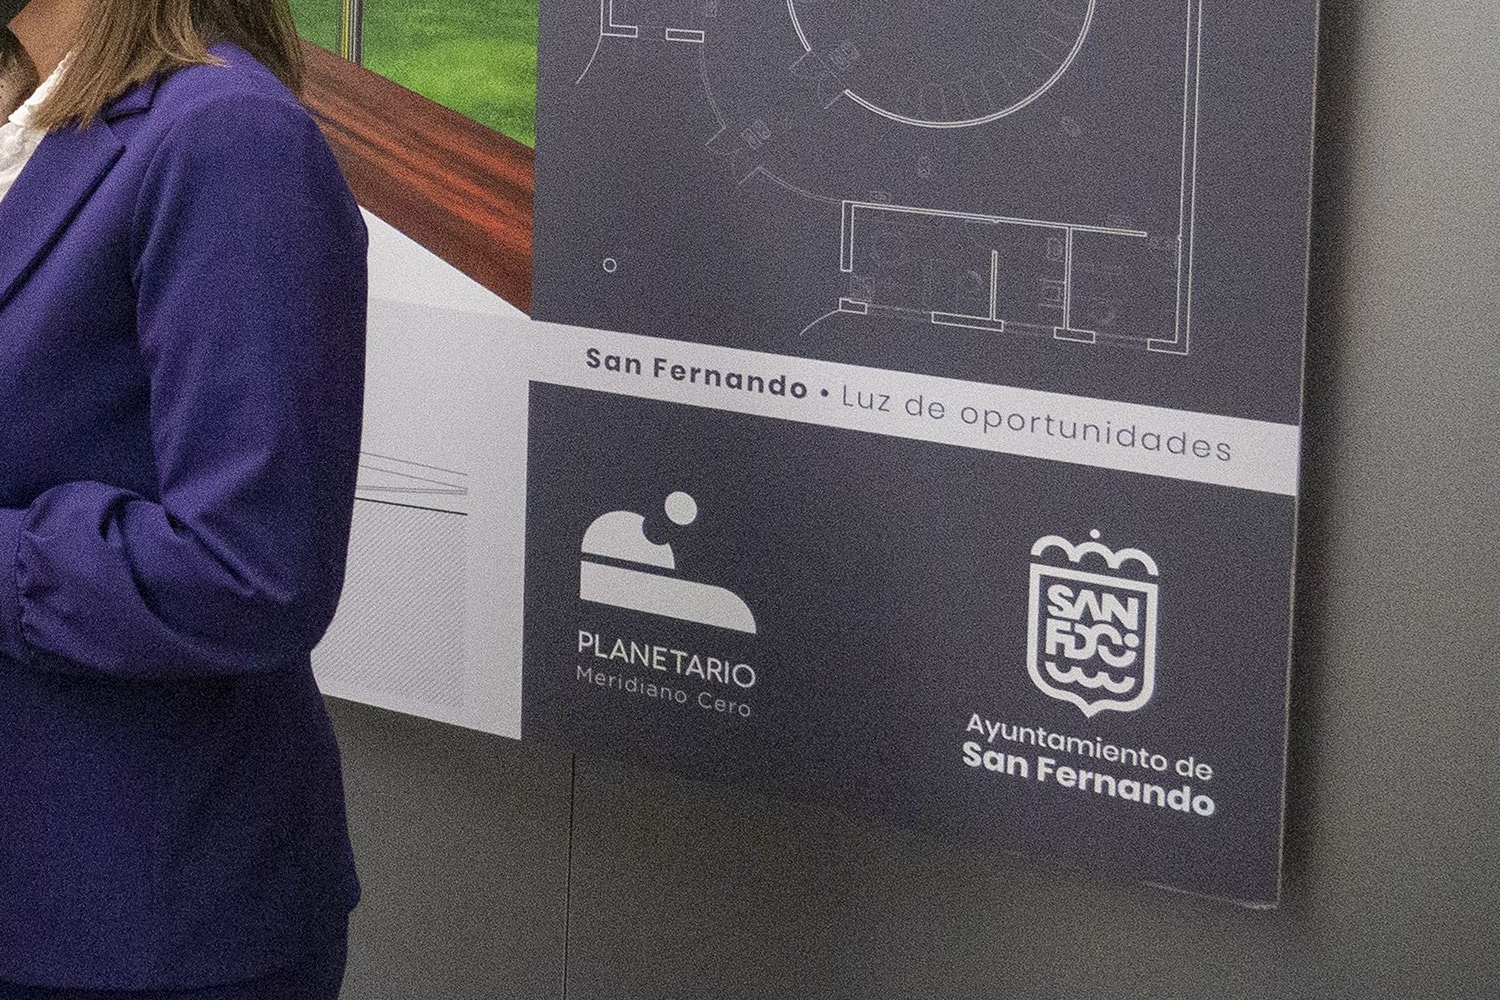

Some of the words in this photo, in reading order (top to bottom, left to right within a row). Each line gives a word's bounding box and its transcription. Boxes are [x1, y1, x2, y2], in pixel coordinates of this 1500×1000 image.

[586, 348, 642, 375] San
[654, 358, 808, 399] Fernando
[842, 385, 891, 413] Luz
[905, 395, 946, 419] de
[961, 406, 1232, 462] oportunidades
[1047, 584, 1139, 630] SAN
[578, 630, 756, 688] PLANETARIO
[576, 665, 687, 703] Meridiano
[698, 692, 751, 717] Cero
[962, 741, 1028, 778] San
[1037, 756, 1215, 816] Fernando
[966, 713, 1168, 771] Ayuntamiento
[1175, 756, 1214, 781] de
